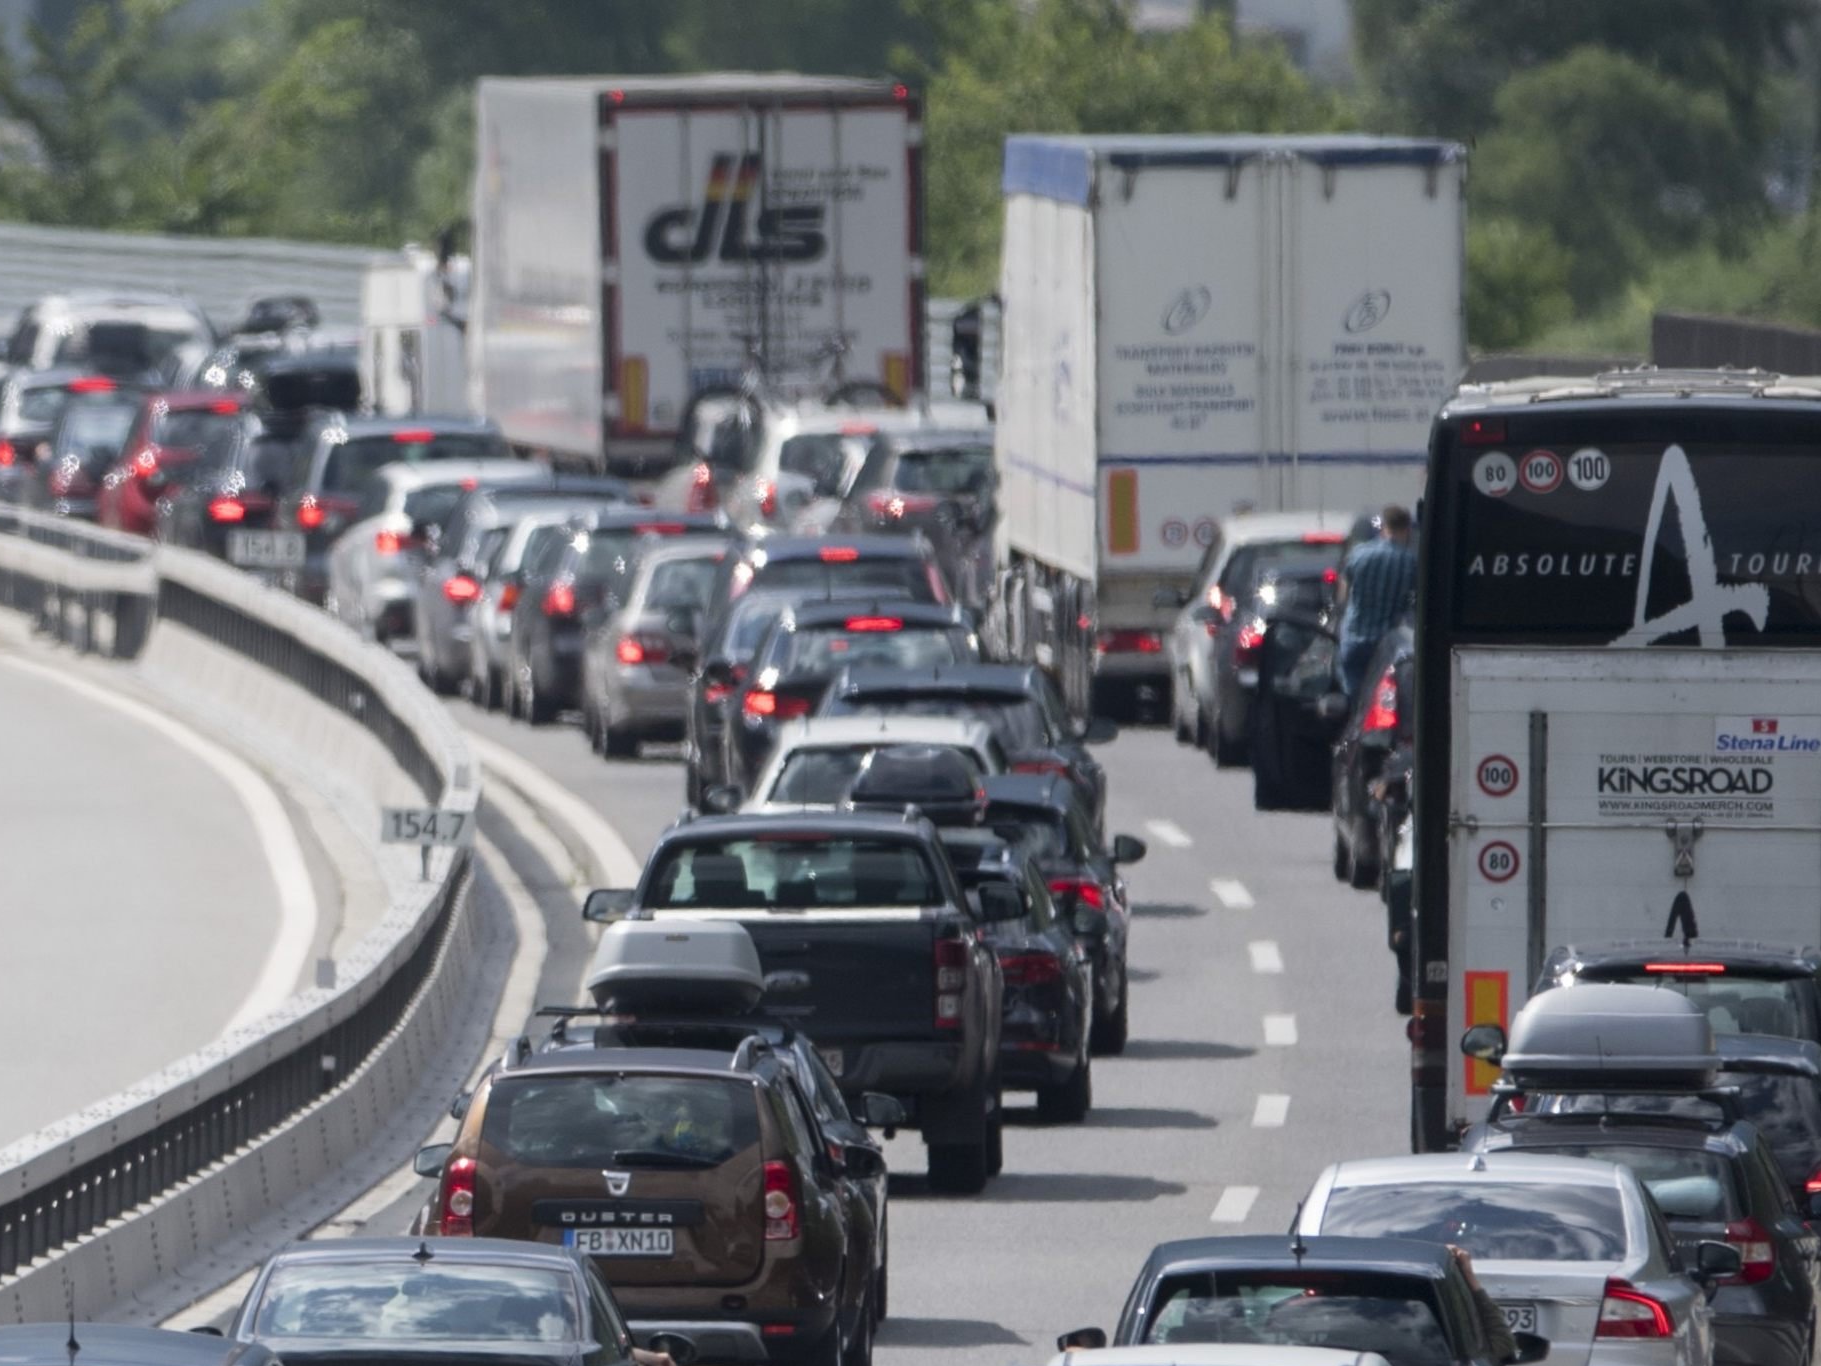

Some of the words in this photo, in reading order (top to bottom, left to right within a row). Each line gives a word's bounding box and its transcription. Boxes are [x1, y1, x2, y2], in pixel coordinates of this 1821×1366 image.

[1485, 466, 1507, 482] 80
[1529, 461, 1555, 479] 100
[1574, 456, 1604, 481] 100
[1468, 554, 1636, 577] ABSOLUTE
[1717, 734, 1775, 751] Stena
[1779, 735, 1820, 751] Line
[1600, 754, 1636, 764] TOURS
[1644, 754, 1701, 764] WEBSTORE
[1710, 754, 1774, 765] WHOLESALE
[1484, 767, 1511, 784] 100
[392, 811, 465, 840] 154.7
[1489, 853, 1510, 870] 80
[561, 1211, 673, 1223] DUSTER
[576, 1231, 602, 1251] FB
